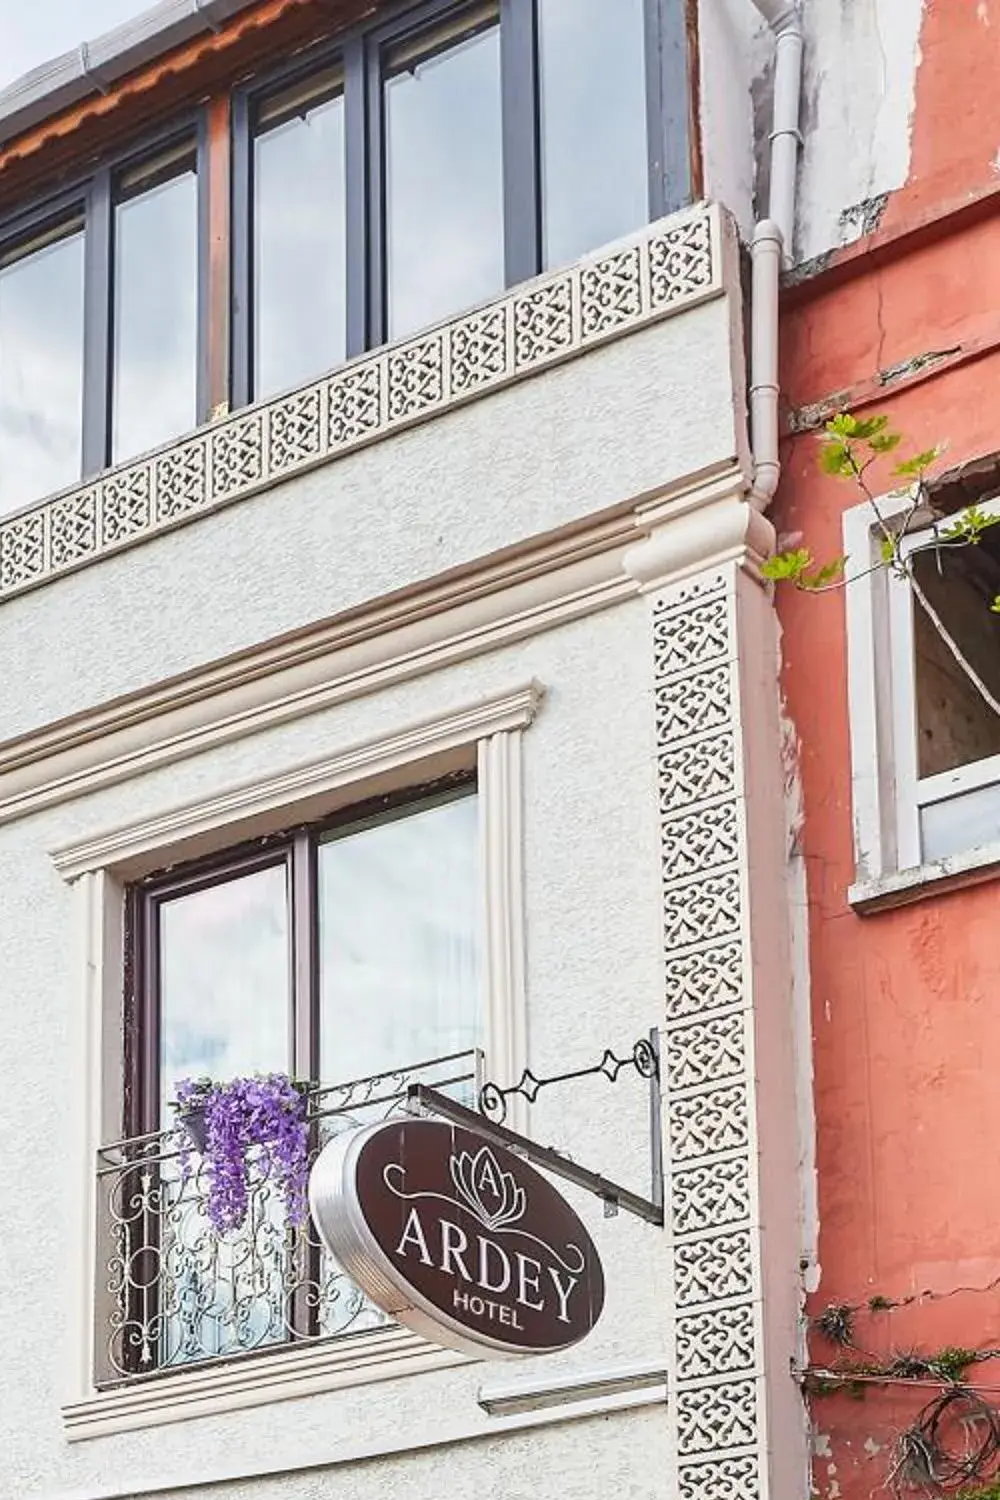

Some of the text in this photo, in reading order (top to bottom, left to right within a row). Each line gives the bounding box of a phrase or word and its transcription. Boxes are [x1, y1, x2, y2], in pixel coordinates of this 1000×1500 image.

[479, 1160, 500, 1196] A
[395, 1207, 578, 1323] ARDEY
[453, 1289, 523, 1330] HOTEL
